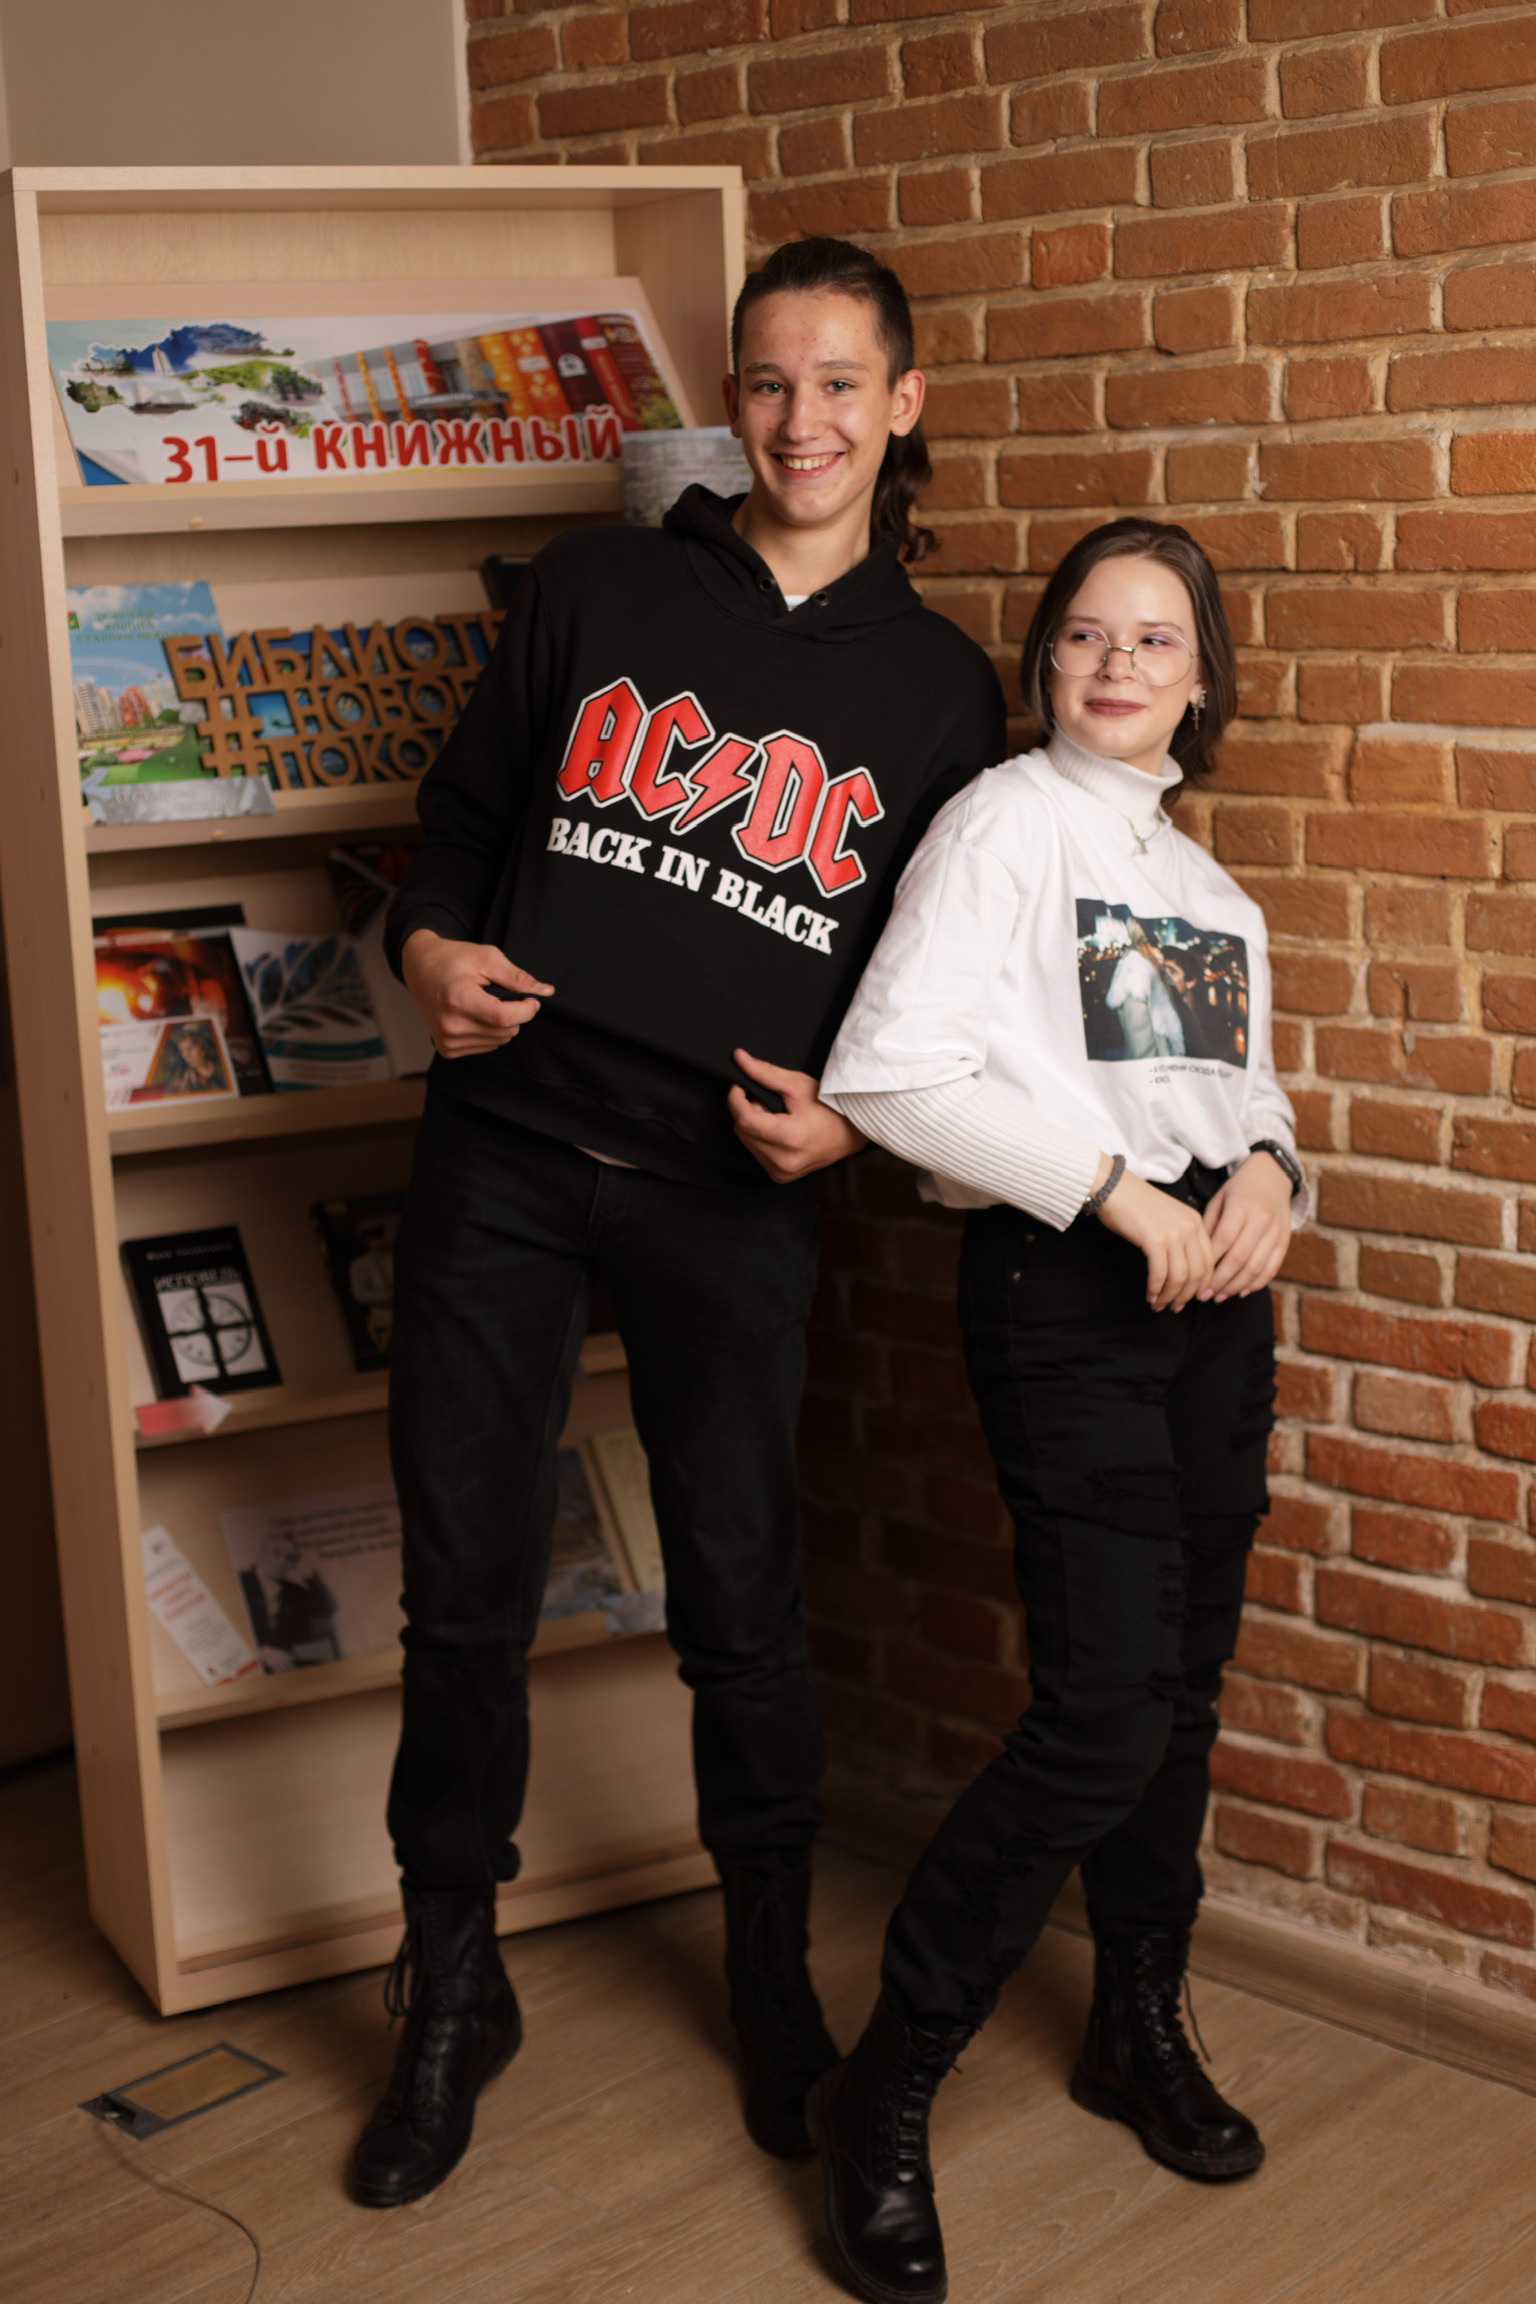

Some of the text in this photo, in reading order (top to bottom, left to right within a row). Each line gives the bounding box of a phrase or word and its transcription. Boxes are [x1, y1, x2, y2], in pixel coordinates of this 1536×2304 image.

[313, 405, 622, 469] КНИЖНЫЙ
[262, 728, 450, 790] ПОКО
[546, 817, 840, 955] BACK IN BLACK
